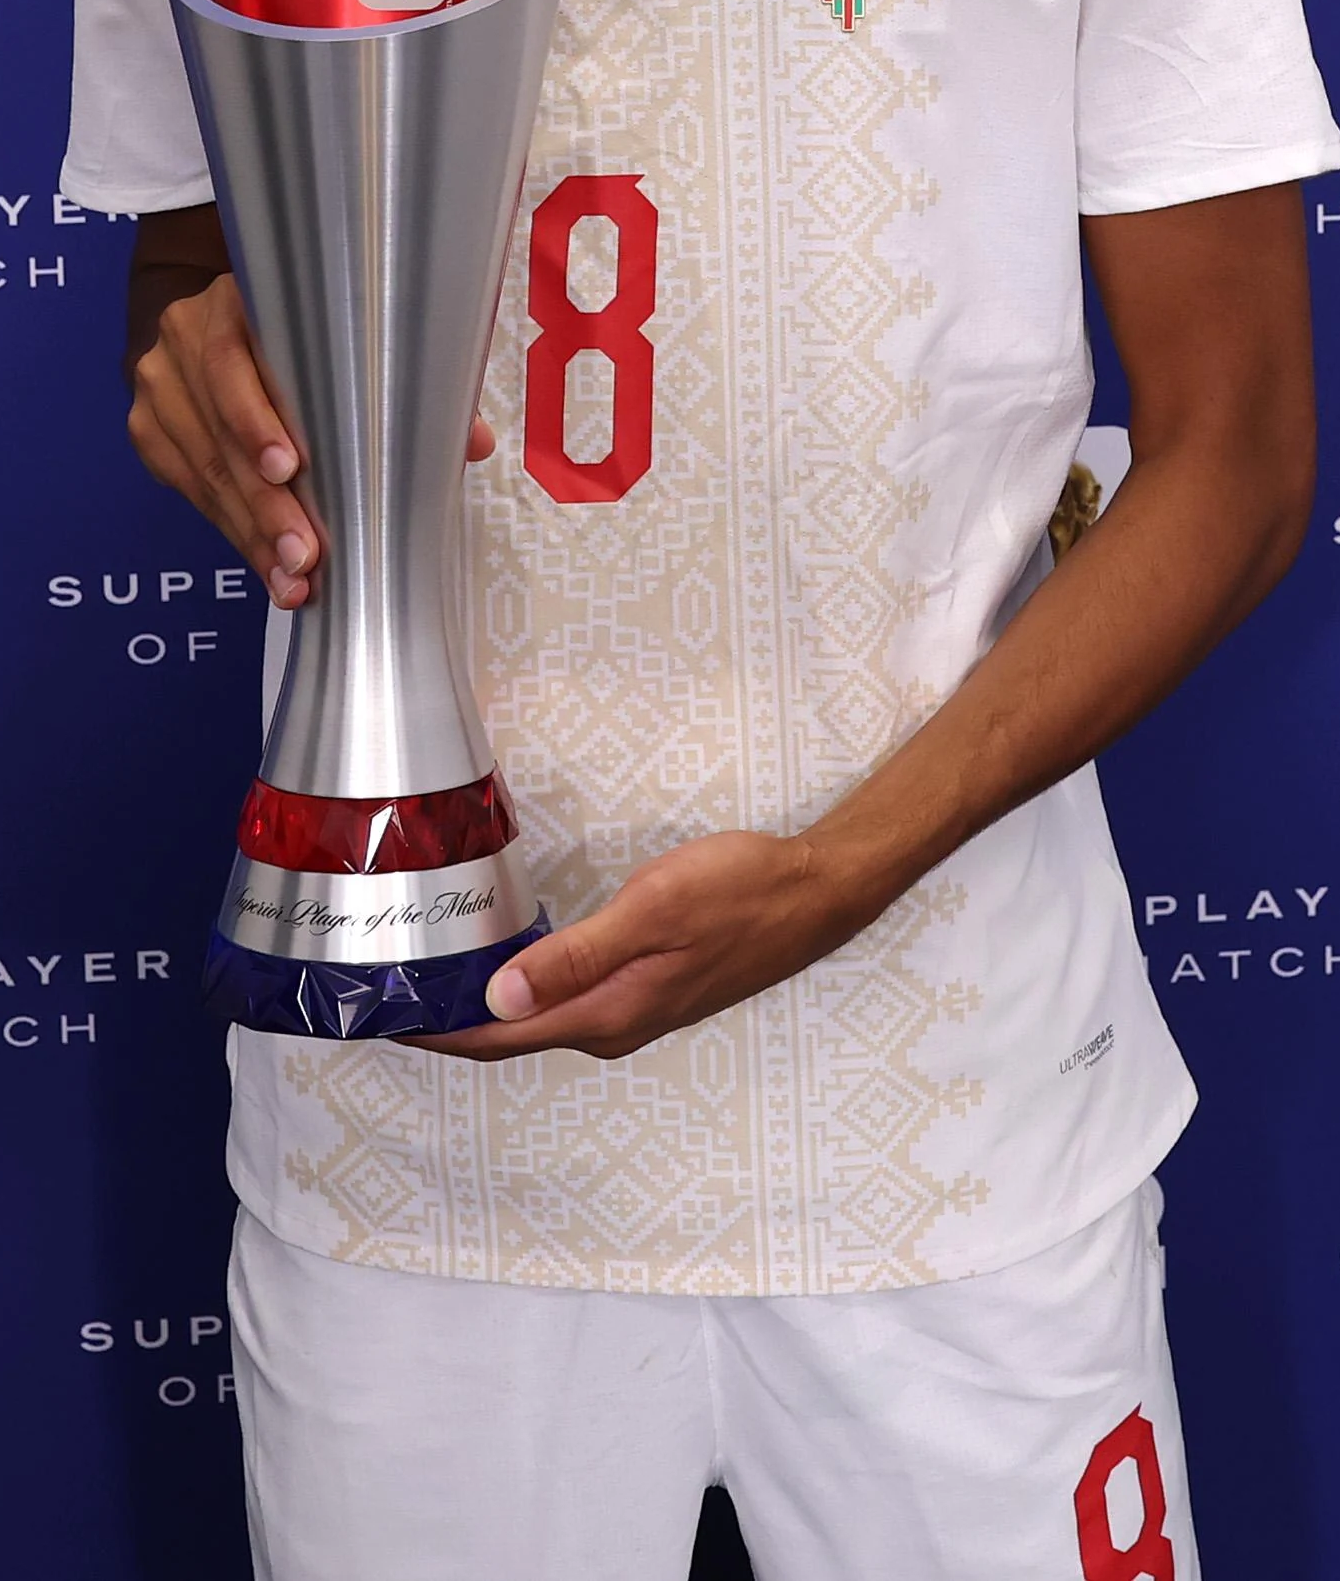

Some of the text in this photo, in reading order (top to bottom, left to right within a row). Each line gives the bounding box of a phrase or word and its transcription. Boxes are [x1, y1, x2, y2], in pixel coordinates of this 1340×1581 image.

[523, 173, 659, 504] 8
[48, 568, 248, 608] SUPE
[127, 631, 218, 665] OF
[361, 904, 395, 937] of
[425, 885, 496, 925] Match
